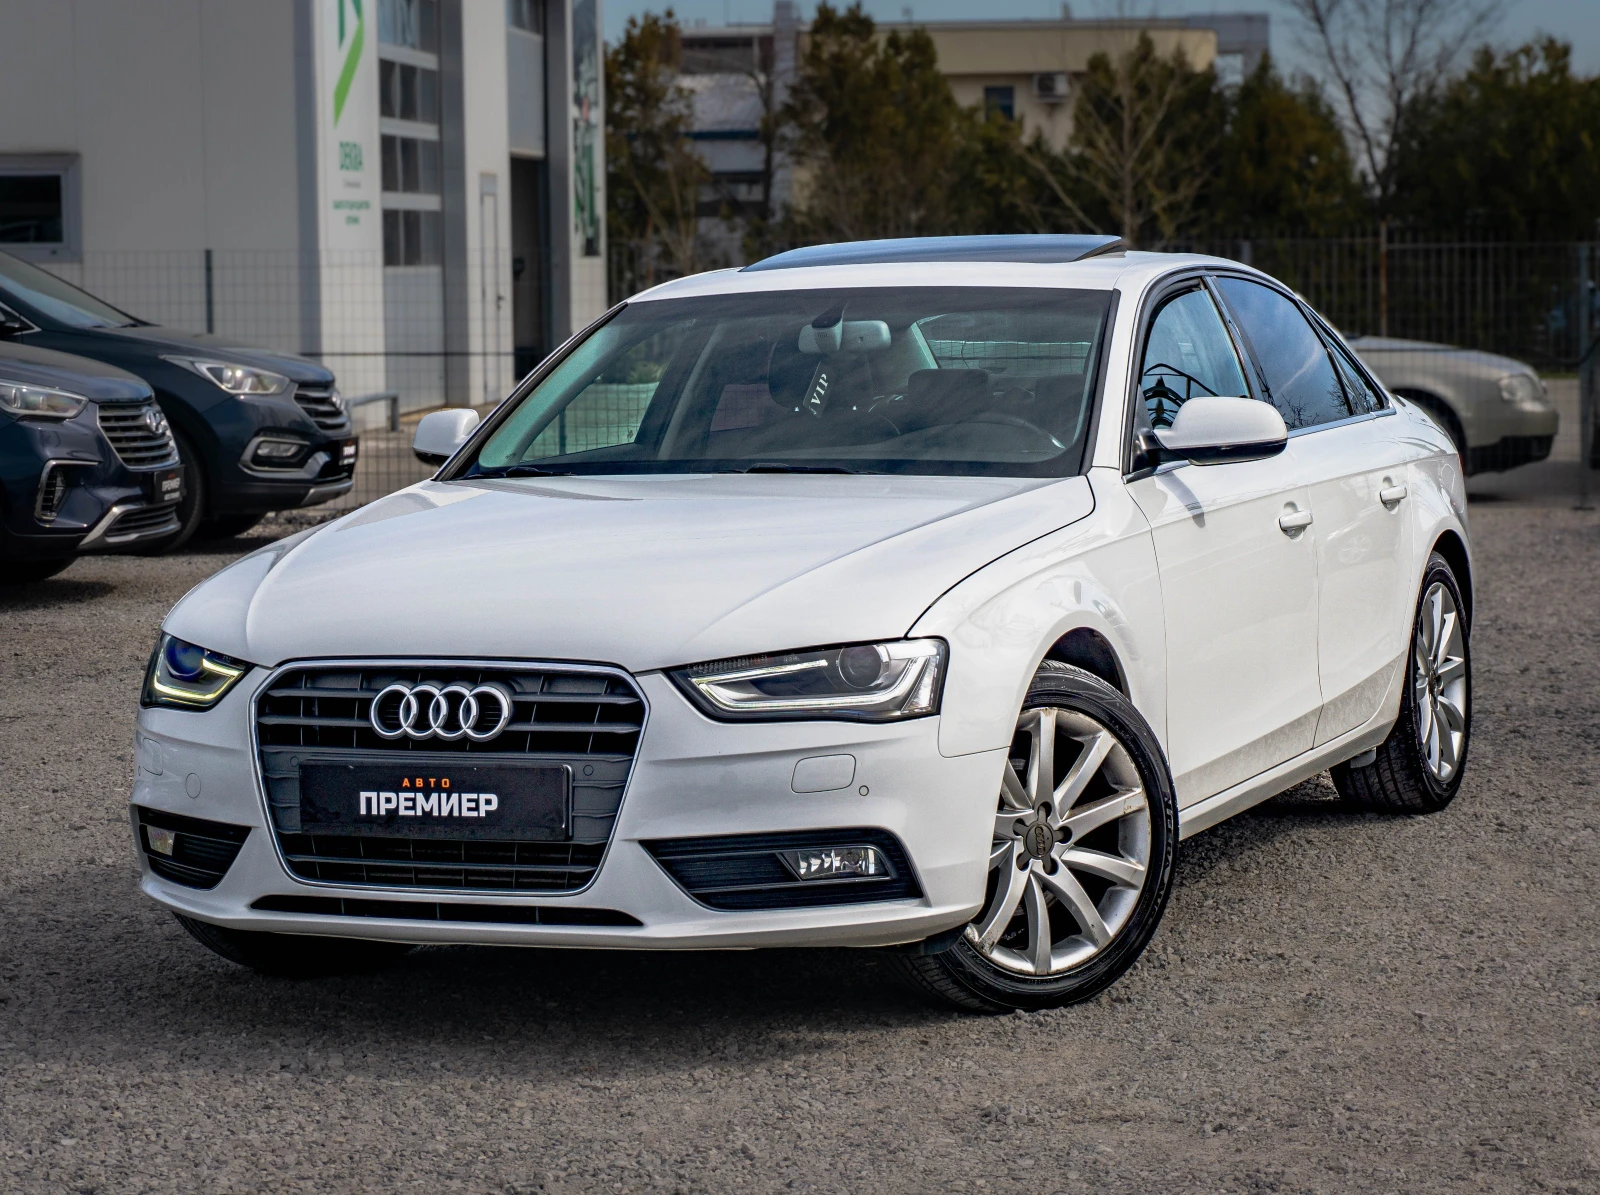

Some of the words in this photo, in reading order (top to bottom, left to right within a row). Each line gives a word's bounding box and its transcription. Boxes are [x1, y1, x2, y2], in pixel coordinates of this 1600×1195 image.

[811, 373, 829, 405] VIP
[402, 778, 451, 788] АВТО
[359, 791, 499, 817] ПРЕМИЕР
